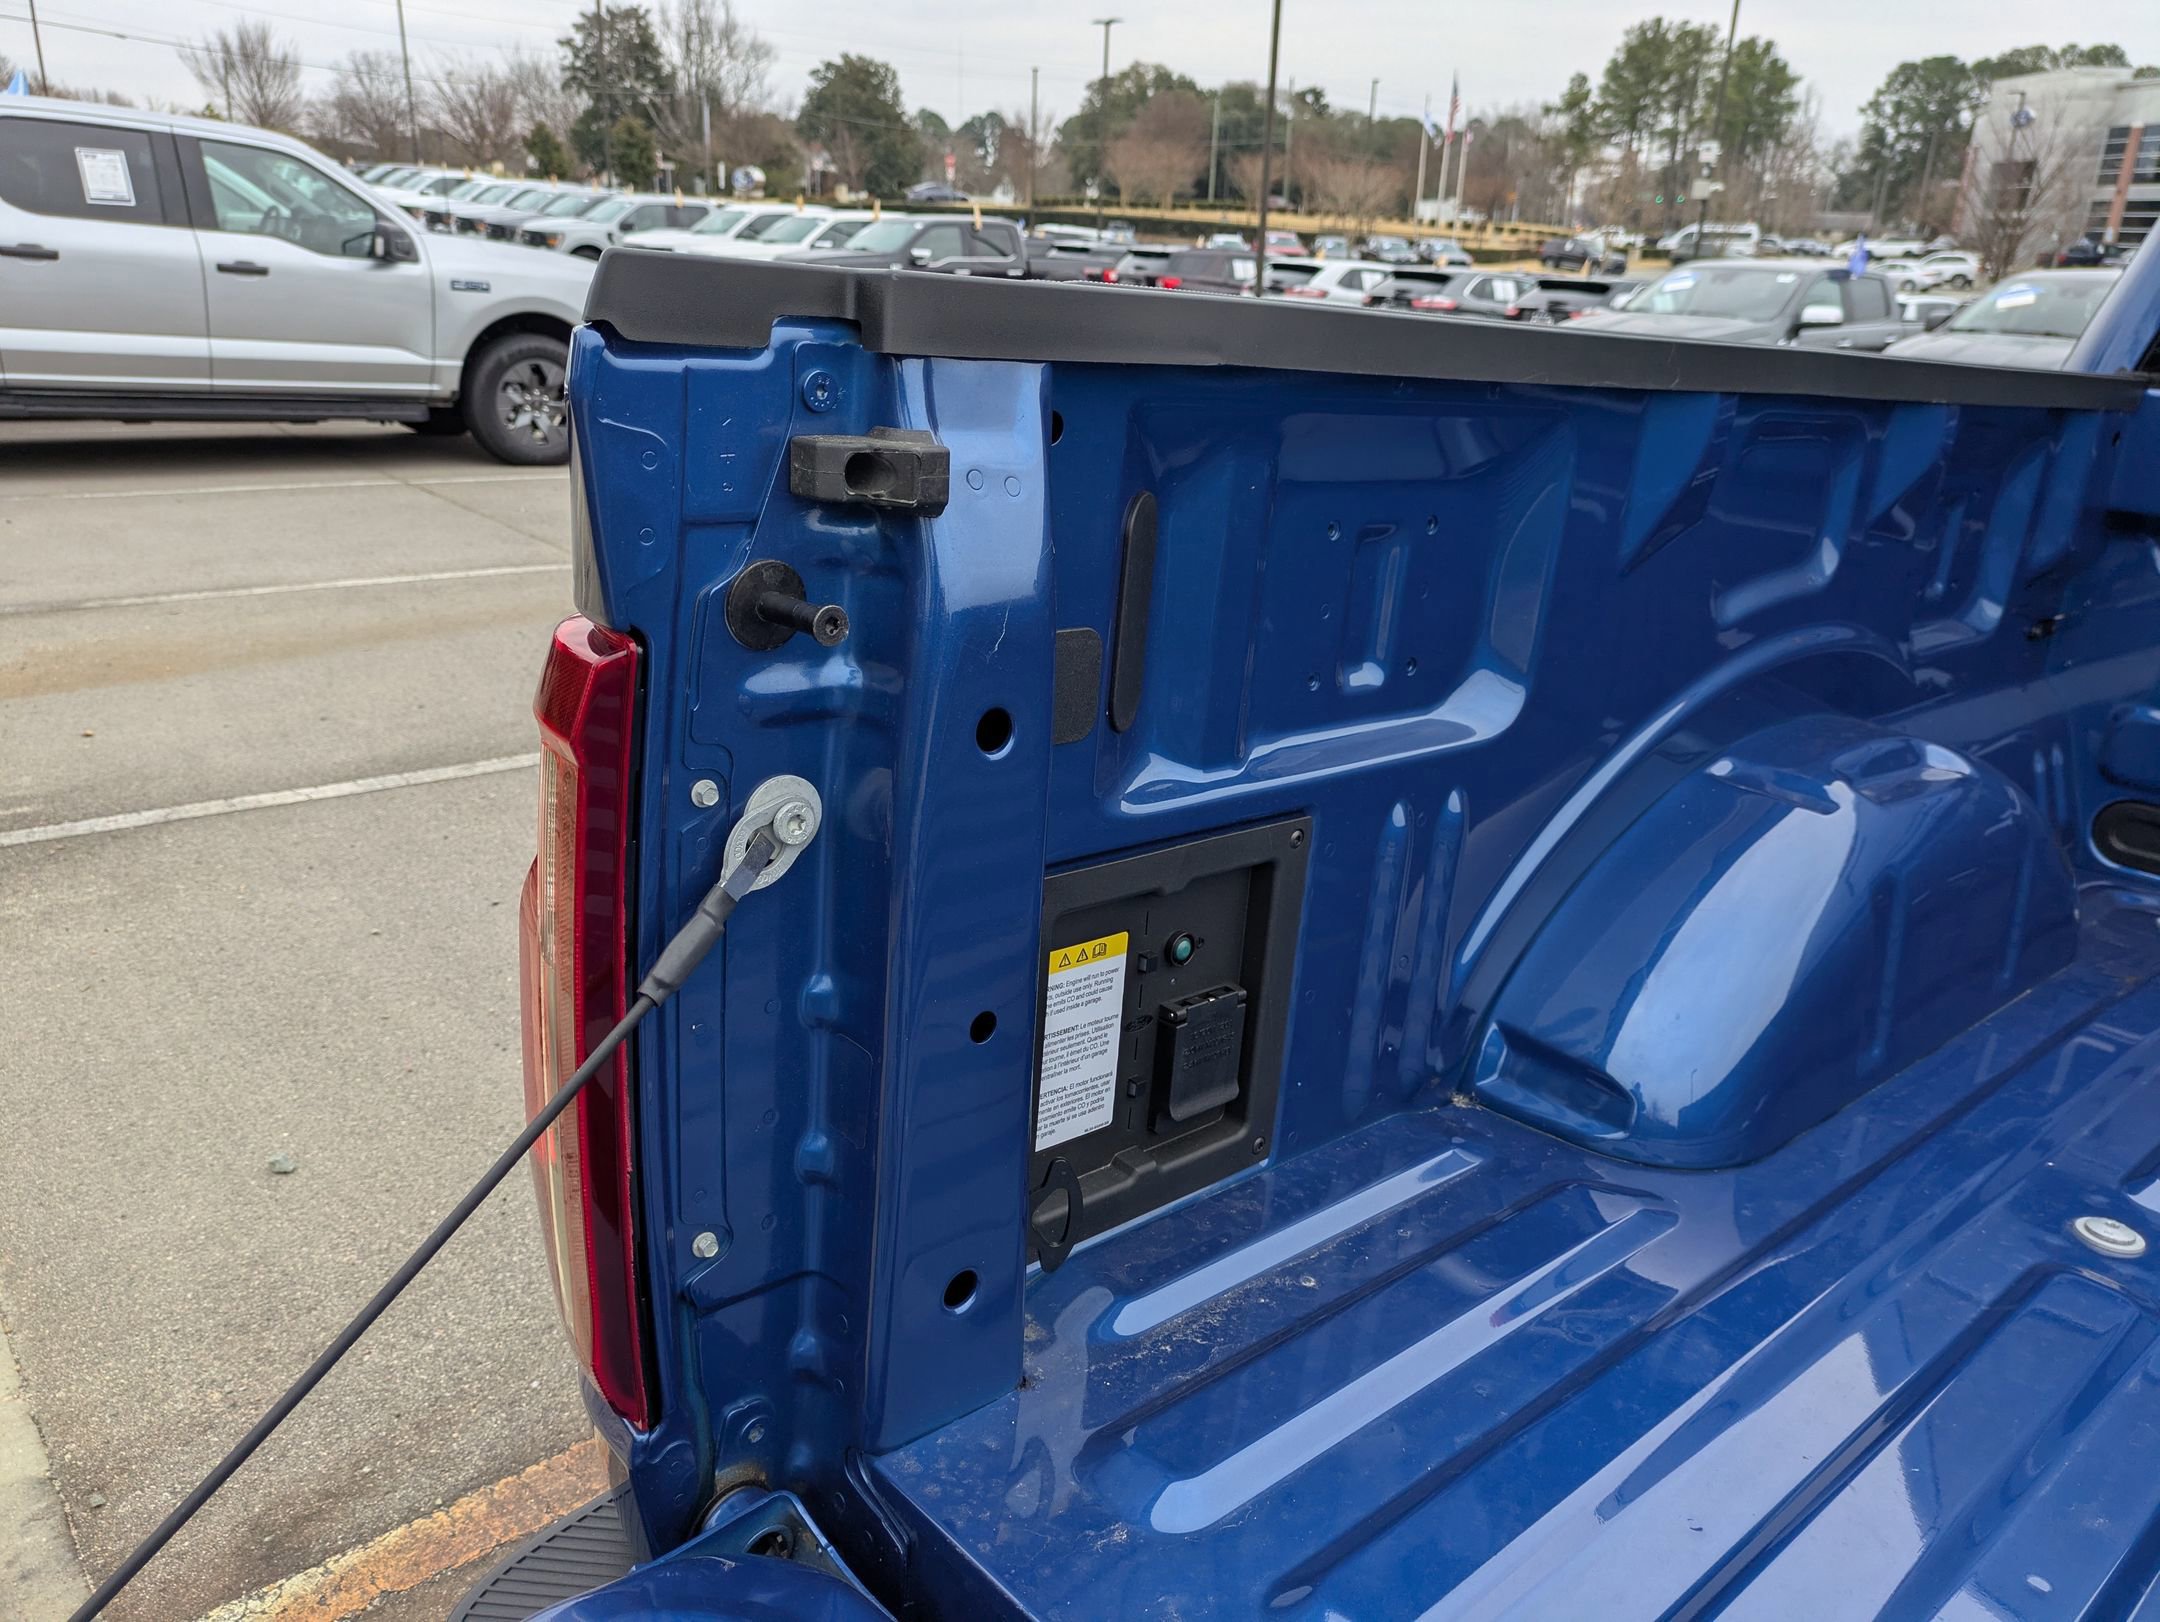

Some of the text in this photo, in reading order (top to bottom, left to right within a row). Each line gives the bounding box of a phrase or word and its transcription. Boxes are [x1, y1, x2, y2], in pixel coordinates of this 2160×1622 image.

[1066, 978, 1082, 987] Engine
[1105, 967, 1119, 976] power
[1055, 989, 1072, 998] outside
[1094, 977, 1113, 987] Running
[1053, 999, 1066, 1007] emits
[1086, 989, 1098, 997] could
[1099, 985, 1112, 993] cause
[1054, 1007, 1065, 1015] used
[1066, 1002, 1080, 1011] inside
[1085, 997, 1101, 1007] garage.
[1045, 1025, 1079, 1040] RTISSEMENT:
[1092, 1023, 1114, 1033] Utilisation
[1087, 1034, 1103, 1043] Quand
[1091, 1049, 1108, 1059] garage
[1040, 1086, 1068, 1100] ERTENCIA:
[1091, 1089, 1104, 1097] motor
[1040, 1098, 1056, 1107] activar
[1049, 1118, 1065, 1127] muerte
[1088, 1104, 1104, 1113] adentro
